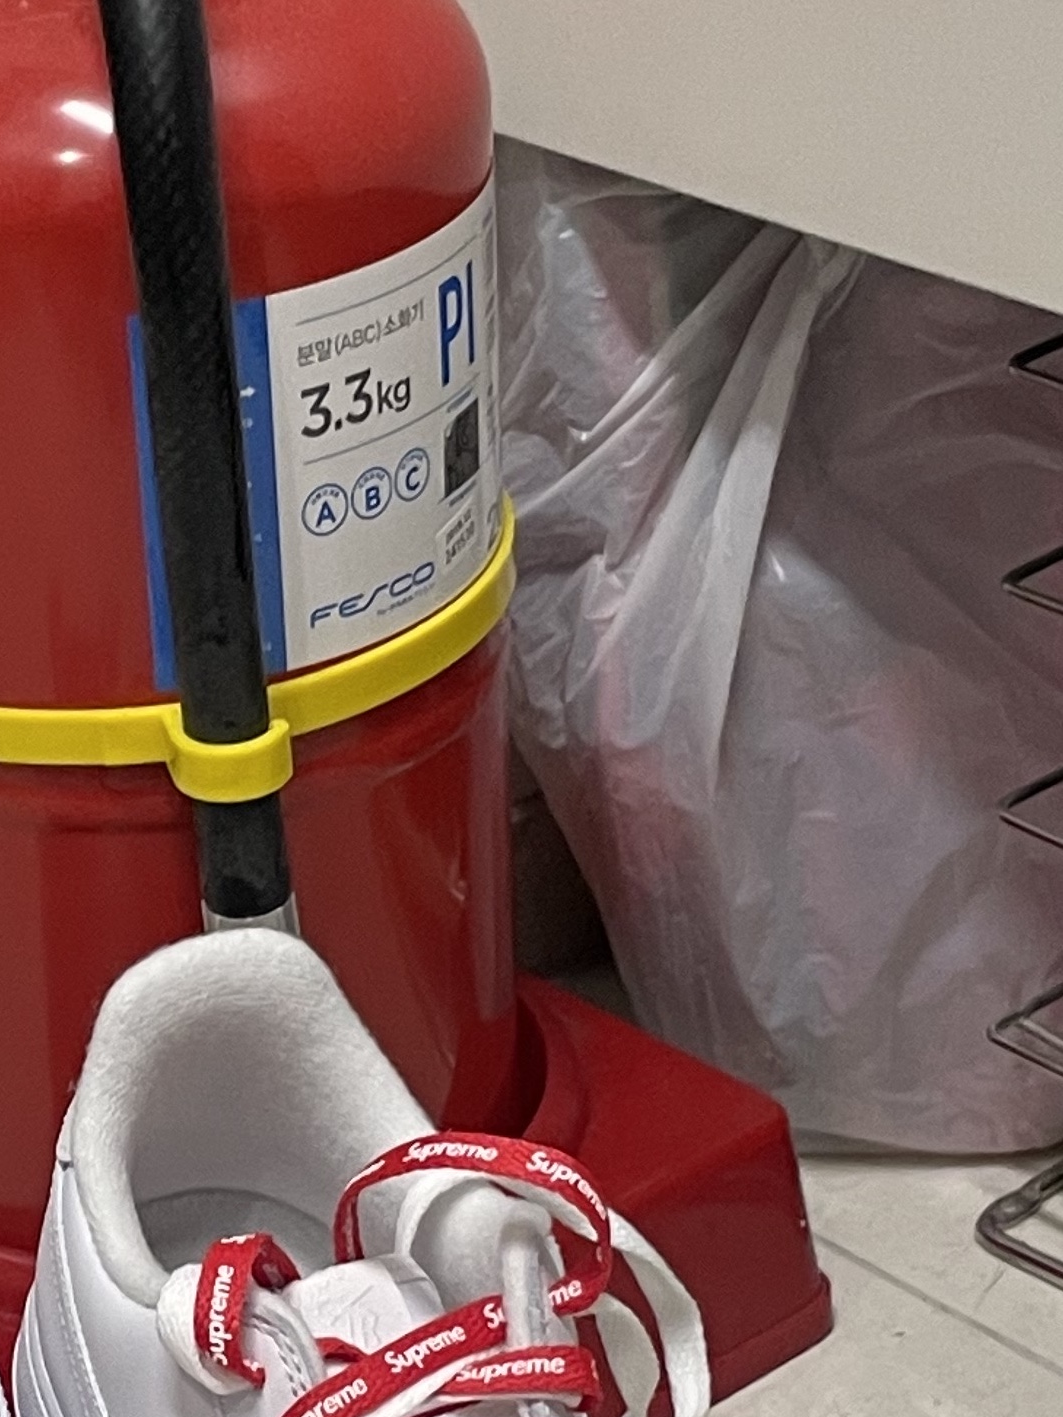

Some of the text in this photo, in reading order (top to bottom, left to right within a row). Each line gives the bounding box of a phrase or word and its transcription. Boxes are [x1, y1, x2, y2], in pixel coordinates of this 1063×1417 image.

[300, 367, 411, 438] 3.3kg
[316, 500, 336, 527] A
[365, 485, 380, 511] B
[405, 466, 421, 491] C
[310, 561, 435, 628] FESCO
[384, 1325, 467, 1374] Supreme
[455, 1356, 566, 1385] Supreme
